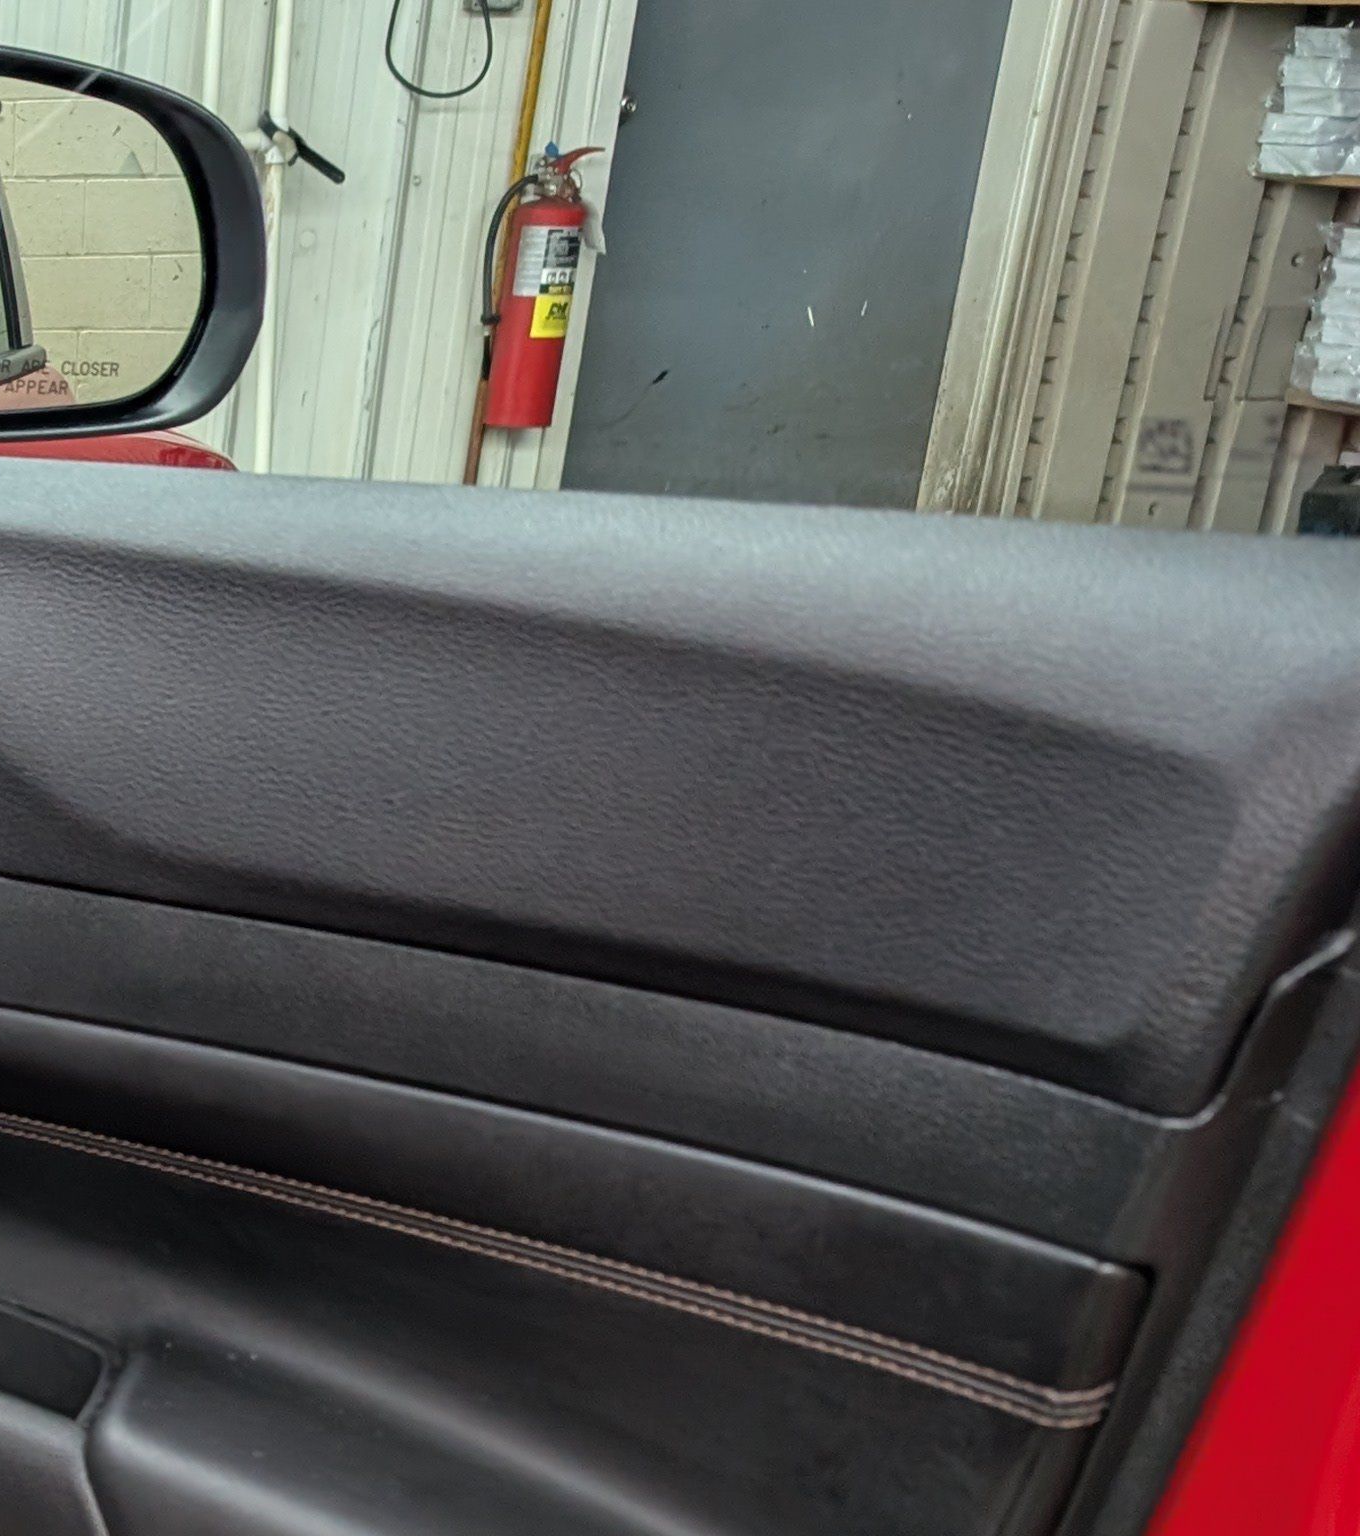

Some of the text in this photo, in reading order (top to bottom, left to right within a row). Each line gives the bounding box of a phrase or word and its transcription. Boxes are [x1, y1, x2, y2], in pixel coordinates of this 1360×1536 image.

[21, 359, 51, 375] ARE
[60, 360, 120, 377] CLOSER
[4, 379, 69, 396] APPEAR
